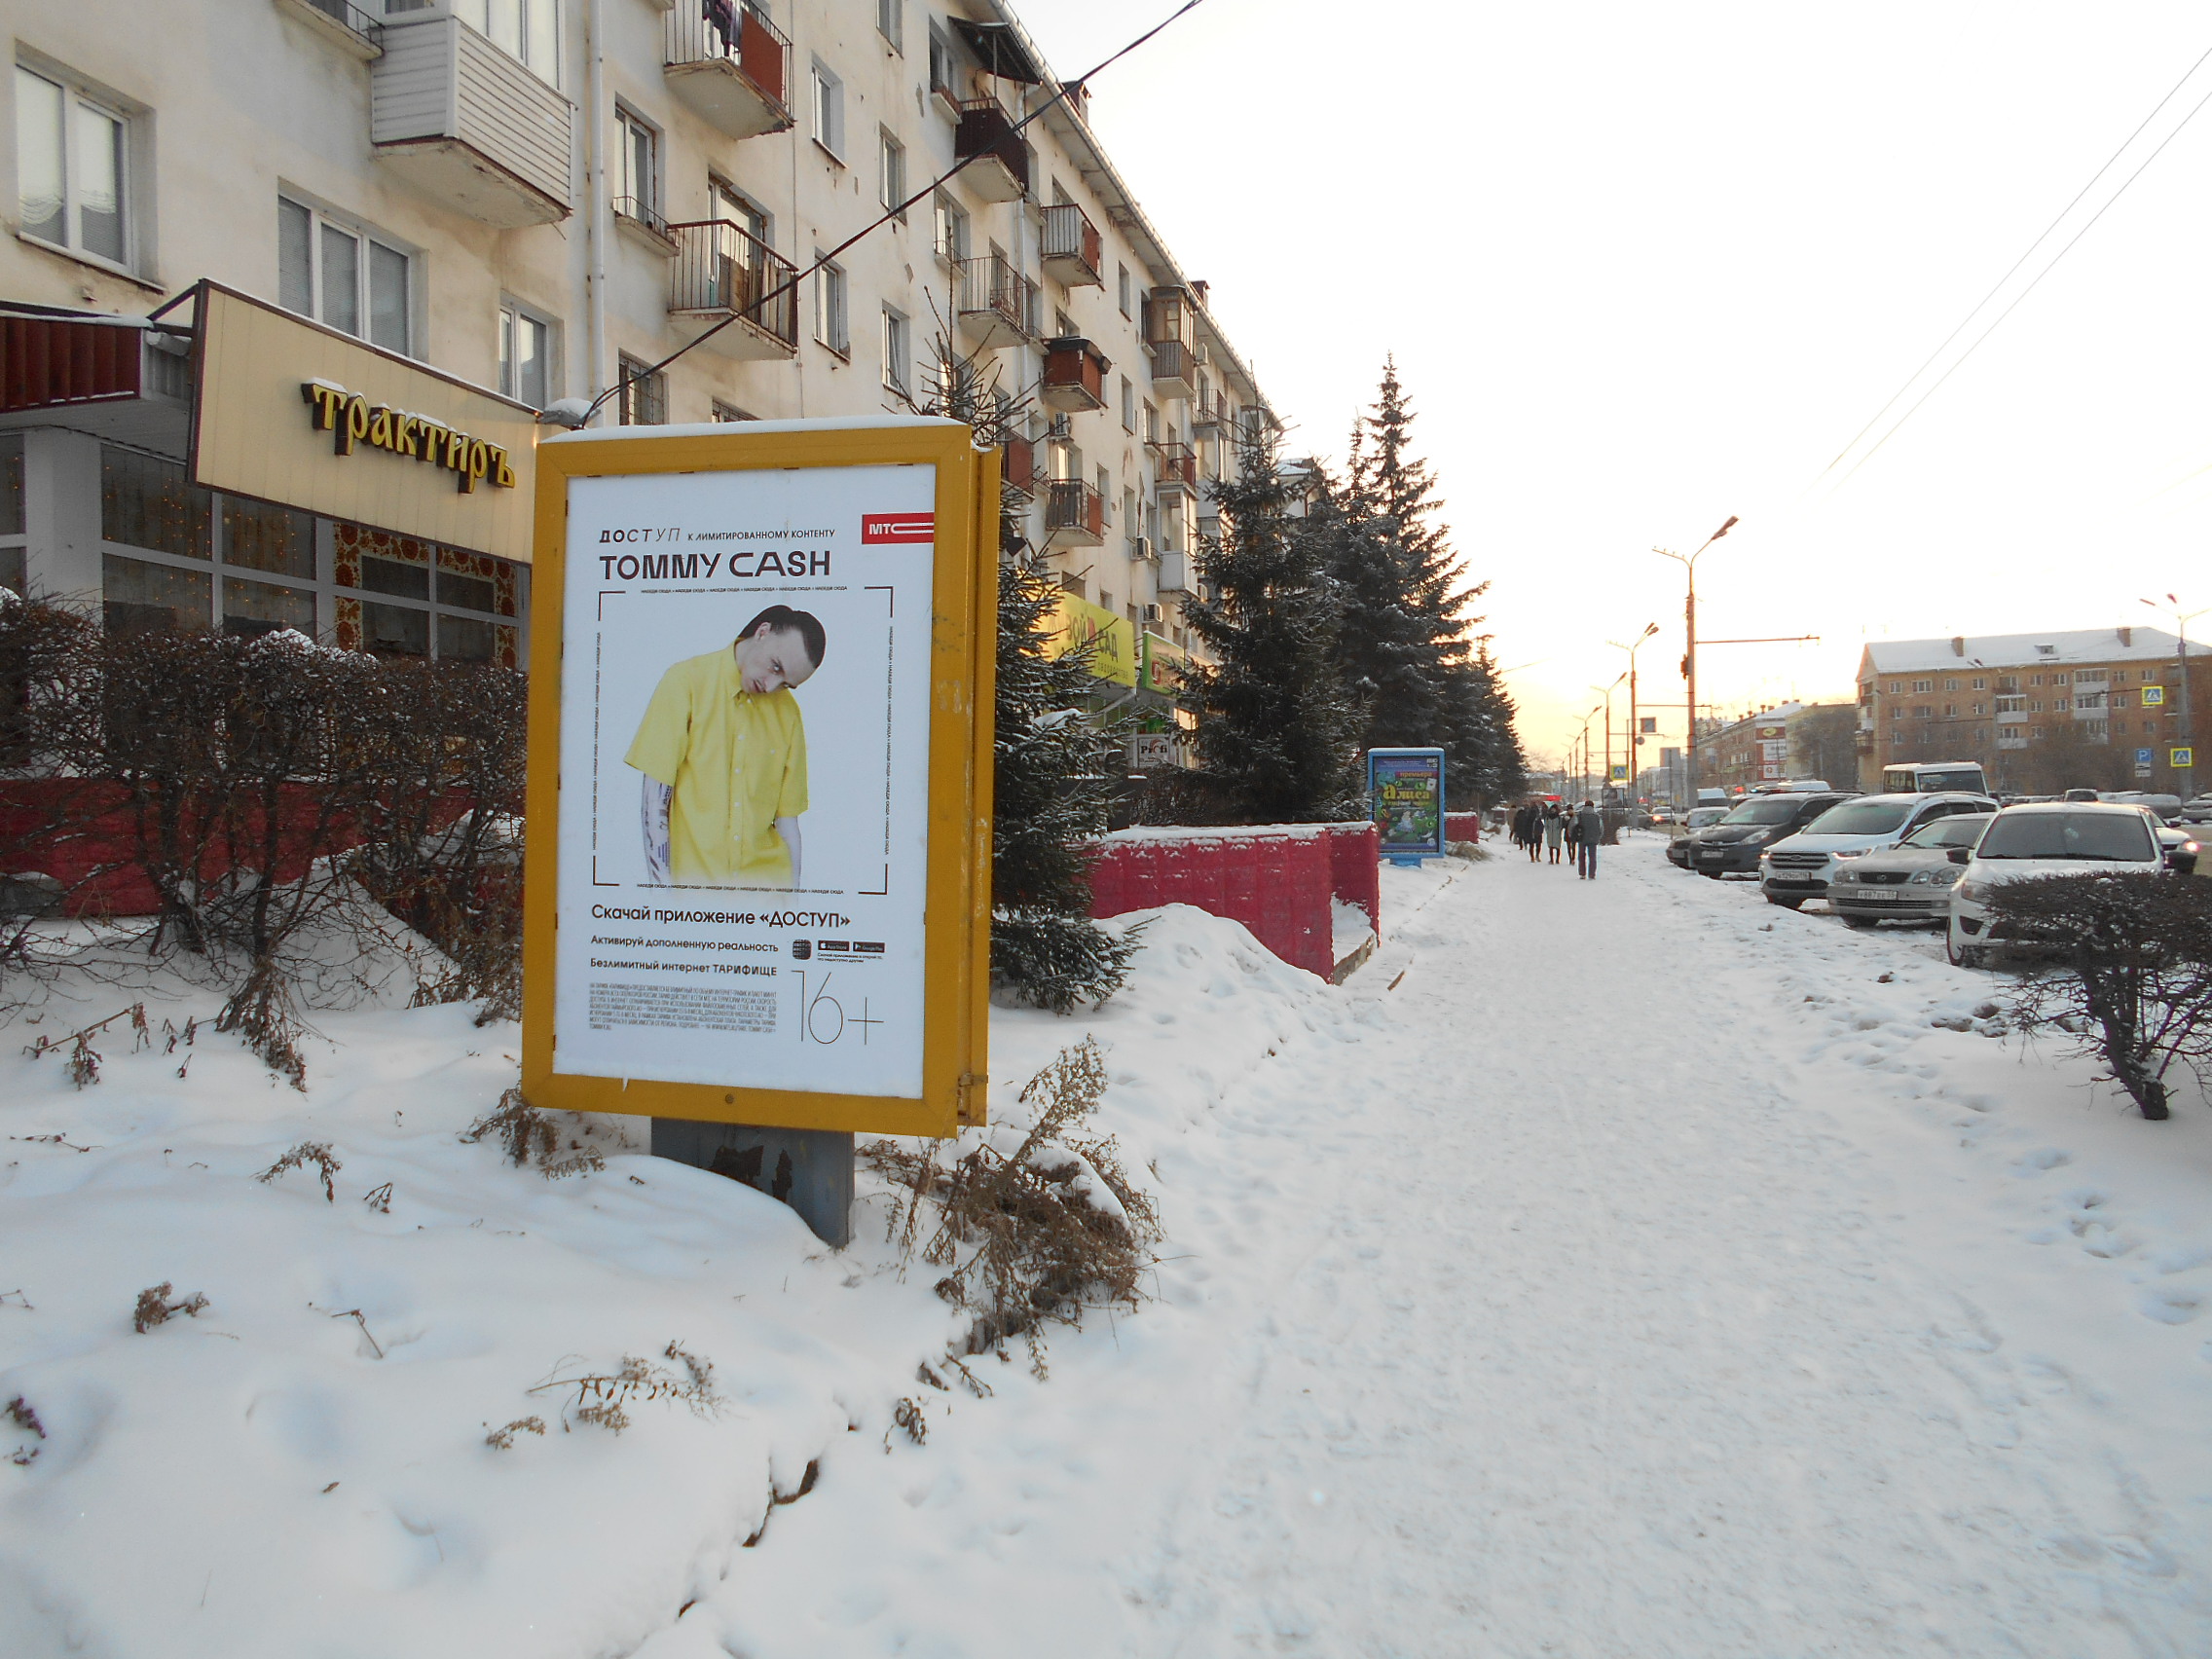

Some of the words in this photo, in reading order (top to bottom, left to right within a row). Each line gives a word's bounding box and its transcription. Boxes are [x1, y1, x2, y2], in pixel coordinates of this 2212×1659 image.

[599, 528, 681, 543] ДОСТУП
[696, 531, 789, 541] ЛИМИТИРОВАННОМУ
[792, 529, 835, 538] КОНТЕНТУ
[599, 553, 721, 580] TOMMY
[729, 550, 830, 577] CASH
[592, 903, 650, 920] Скачай
[654, 908, 756, 925] приложение
[759, 910, 851, 928] «ДОСТУП»
[591, 935, 645, 948] Активируй
[645, 939, 717, 950] дополненную
[718, 941, 779, 952] реальность
[590, 957, 659, 971] Безлимитный
[661, 962, 710, 974] интернет
[713, 964, 777, 977] ТАРИФИЩЕ
[791, 970, 884, 1045] 16+
